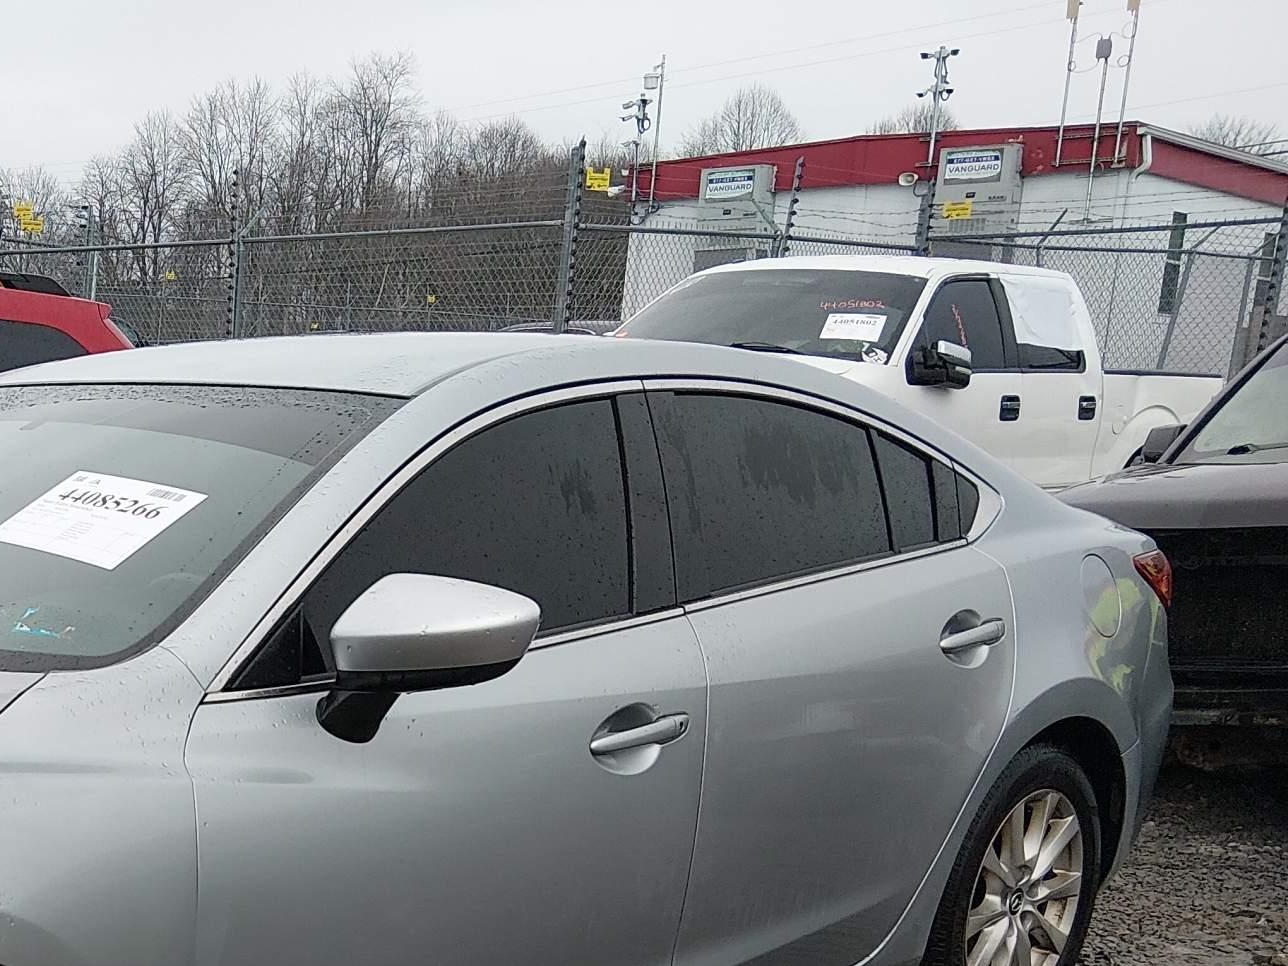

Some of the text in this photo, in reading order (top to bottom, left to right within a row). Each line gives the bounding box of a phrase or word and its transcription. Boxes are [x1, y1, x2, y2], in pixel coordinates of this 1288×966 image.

[948, 163, 1000, 173] VANGUARD
[709, 183, 752, 192] VANGUARD
[820, 299, 885, 310] 44051802
[59, 488, 168, 519] 44085266
